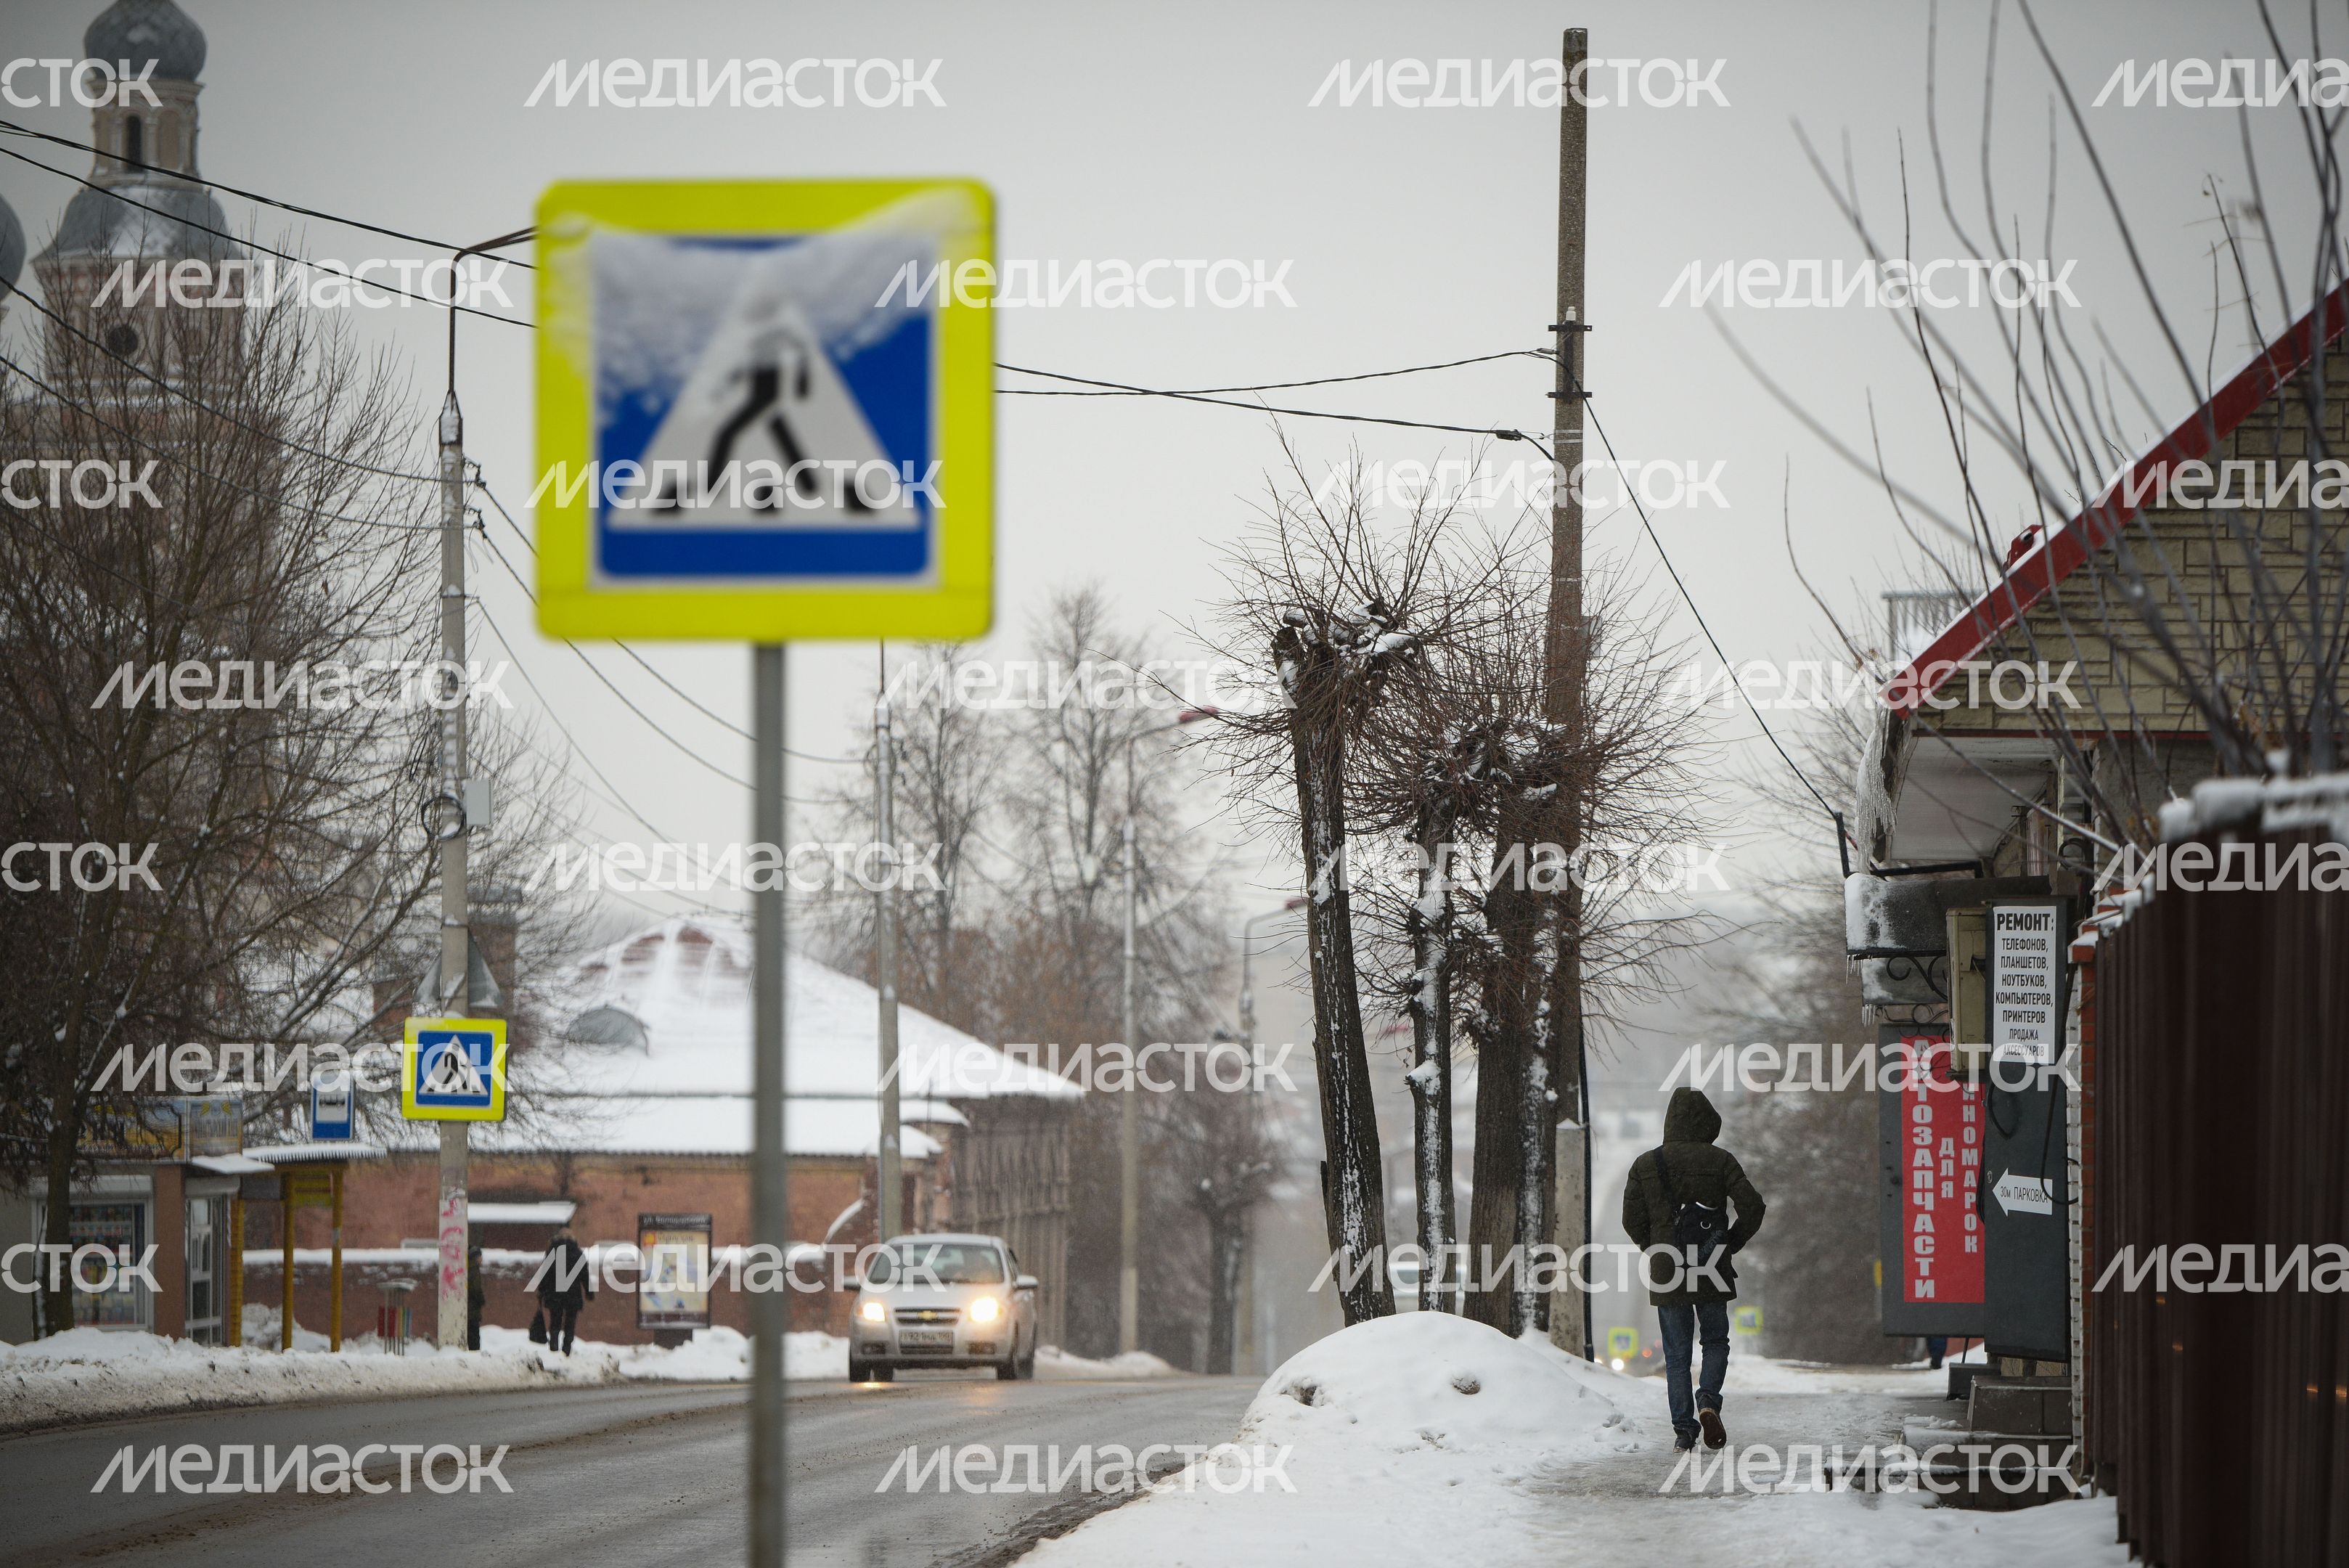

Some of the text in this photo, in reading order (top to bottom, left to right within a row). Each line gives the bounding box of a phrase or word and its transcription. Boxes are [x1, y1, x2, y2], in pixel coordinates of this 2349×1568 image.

[1997, 913, 2054, 931] РЕМОНТ:
[2002, 938, 2048, 952] ТЕЛЕФОНОВ,
[2001, 956, 2048, 971] ПЛАНШЕТОВ,
[2002, 974, 2047, 989] НОУТБУКОВ,
[1995, 992, 2054, 1008] КОМПЬЮТЕРОВ,
[2003, 1010, 2046, 1024] ПРИНТЕРОВ
[2009, 1029, 2039, 1042] ПРОДАЖА
[2003, 1045, 2044, 1057] АКСЕССУАРОВ
[1939, 1137, 1955, 1199] ДЛЯ
[1961, 1082, 1978, 1253] ИНОМАРОК
[2000, 1186, 2048, 1204] 30м ПАРКОВКА
